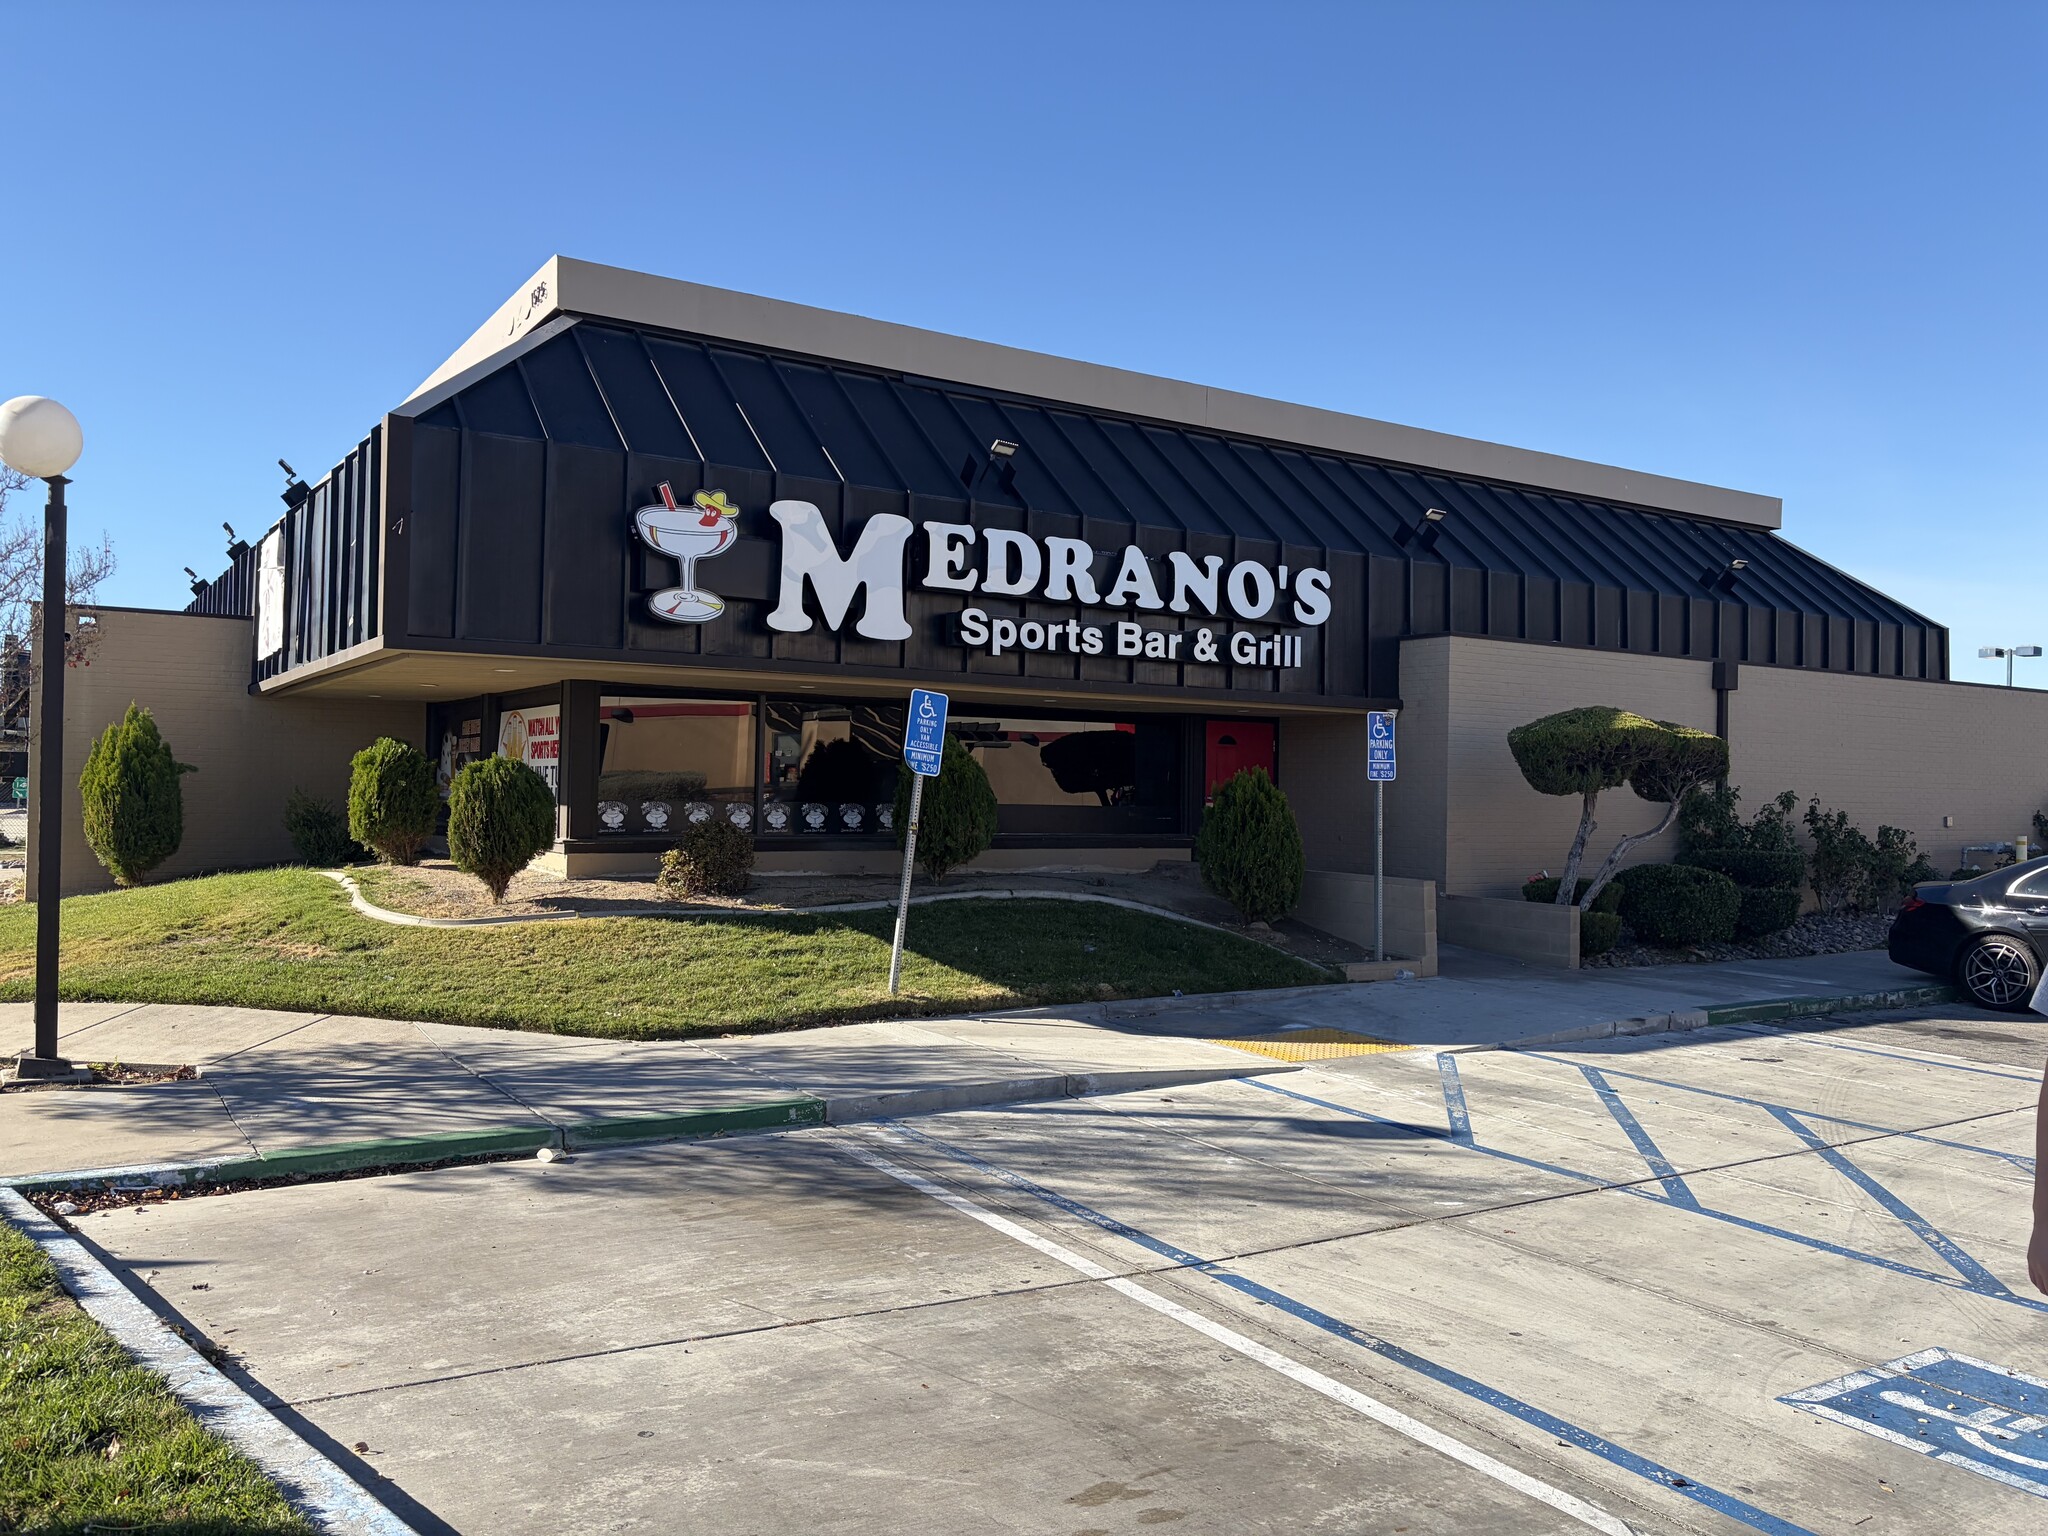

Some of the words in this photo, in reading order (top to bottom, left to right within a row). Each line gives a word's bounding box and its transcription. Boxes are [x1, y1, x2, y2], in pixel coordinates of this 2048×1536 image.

[766, 499, 1332, 642] MEDRANO'S
[960, 608, 1104, 657] Sports
[1116, 620, 1183, 660] Bar
[1193, 627, 1219, 662] &
[1230, 630, 1302, 668] Grill
[528, 718, 544, 737] WATCH
[545, 715, 555, 736] ALL
[916, 717, 938, 728] PARKING
[919, 726, 933, 734] ONLY
[920, 733, 930, 742] VAN
[531, 741, 549, 759] SPORTS
[910, 740, 938, 751] ACCESSIBLE
[1370, 739, 1393, 750] PARKING
[910, 751, 935, 763] MINIMUM
[1374, 750, 1388, 760] ONLY
[921, 761, 938, 773] $250
[1372, 762, 1391, 770] MINIMUM
[1369, 770, 1379, 778] FINE
[1380, 770, 1394, 778] $250
